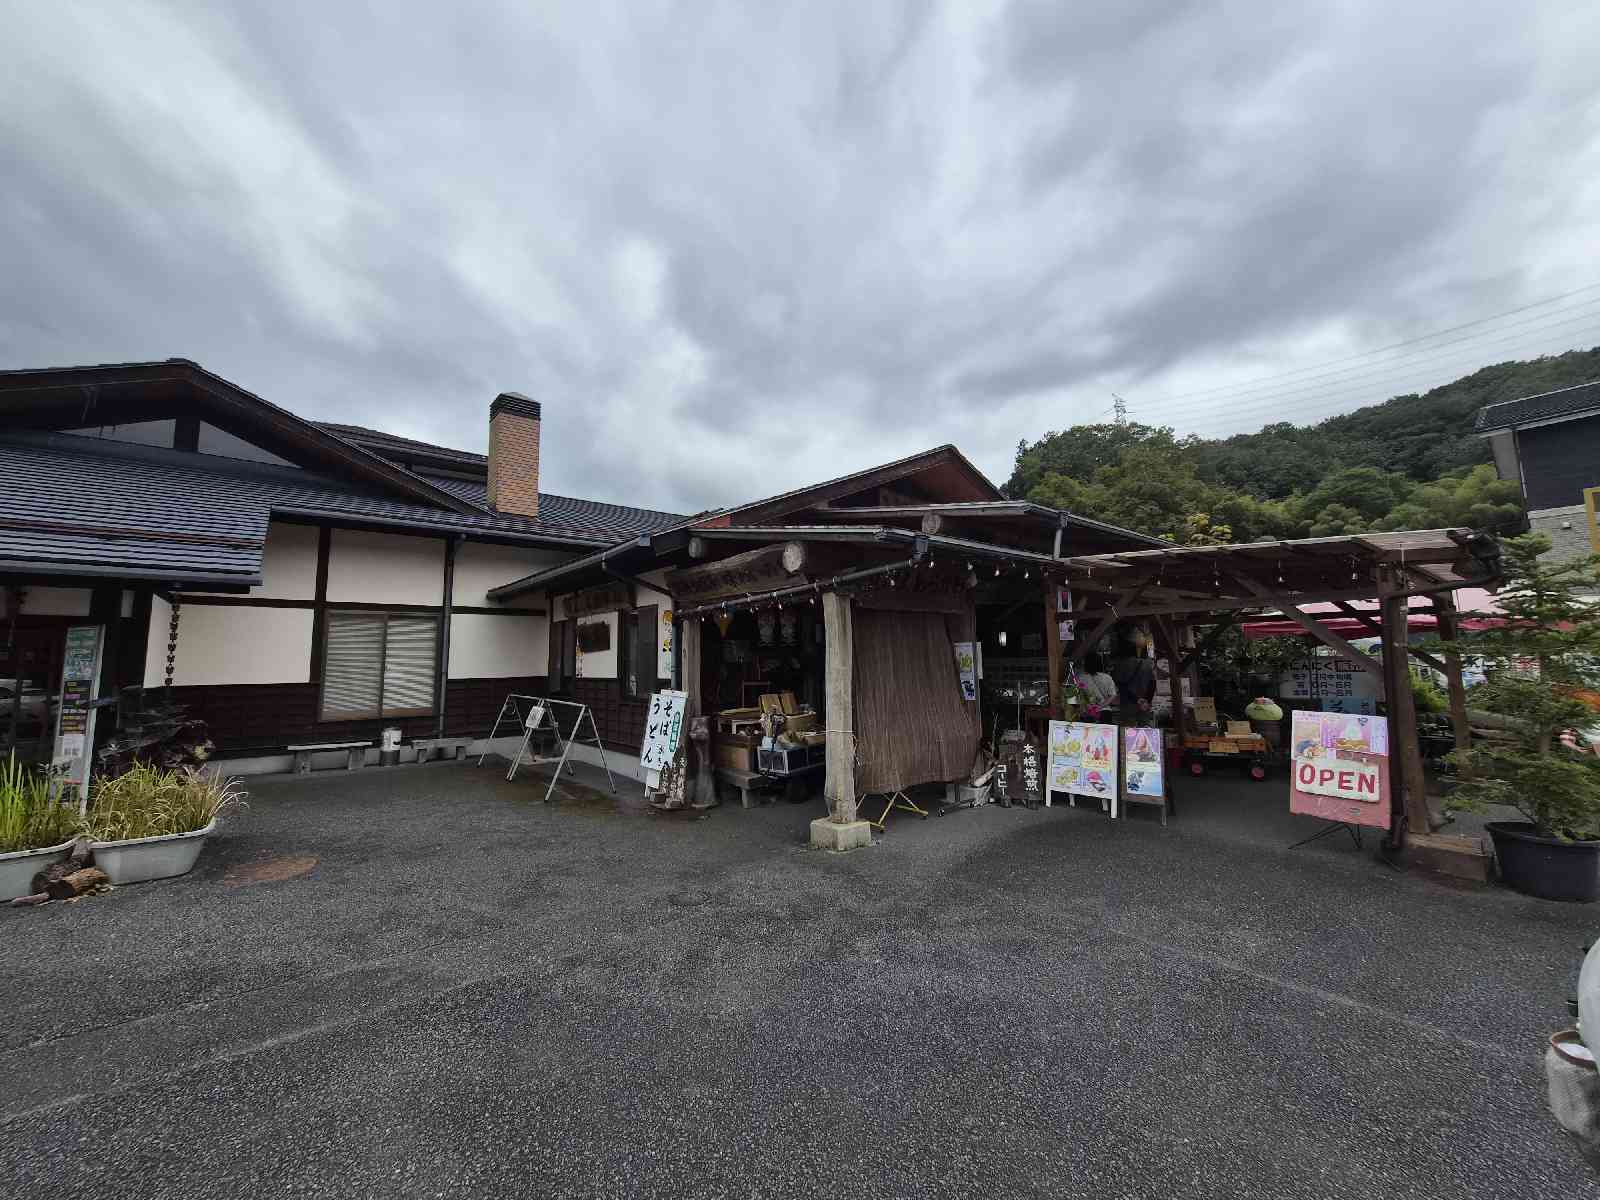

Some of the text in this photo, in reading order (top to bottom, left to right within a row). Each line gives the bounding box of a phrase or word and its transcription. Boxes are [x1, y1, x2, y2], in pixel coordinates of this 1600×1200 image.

[660, 700, 673, 736] そば
[997, 764, 1009, 797] コーヒー
[1023, 743, 1039, 792] 本格焙煎
[1299, 763, 1376, 794] OPEN
